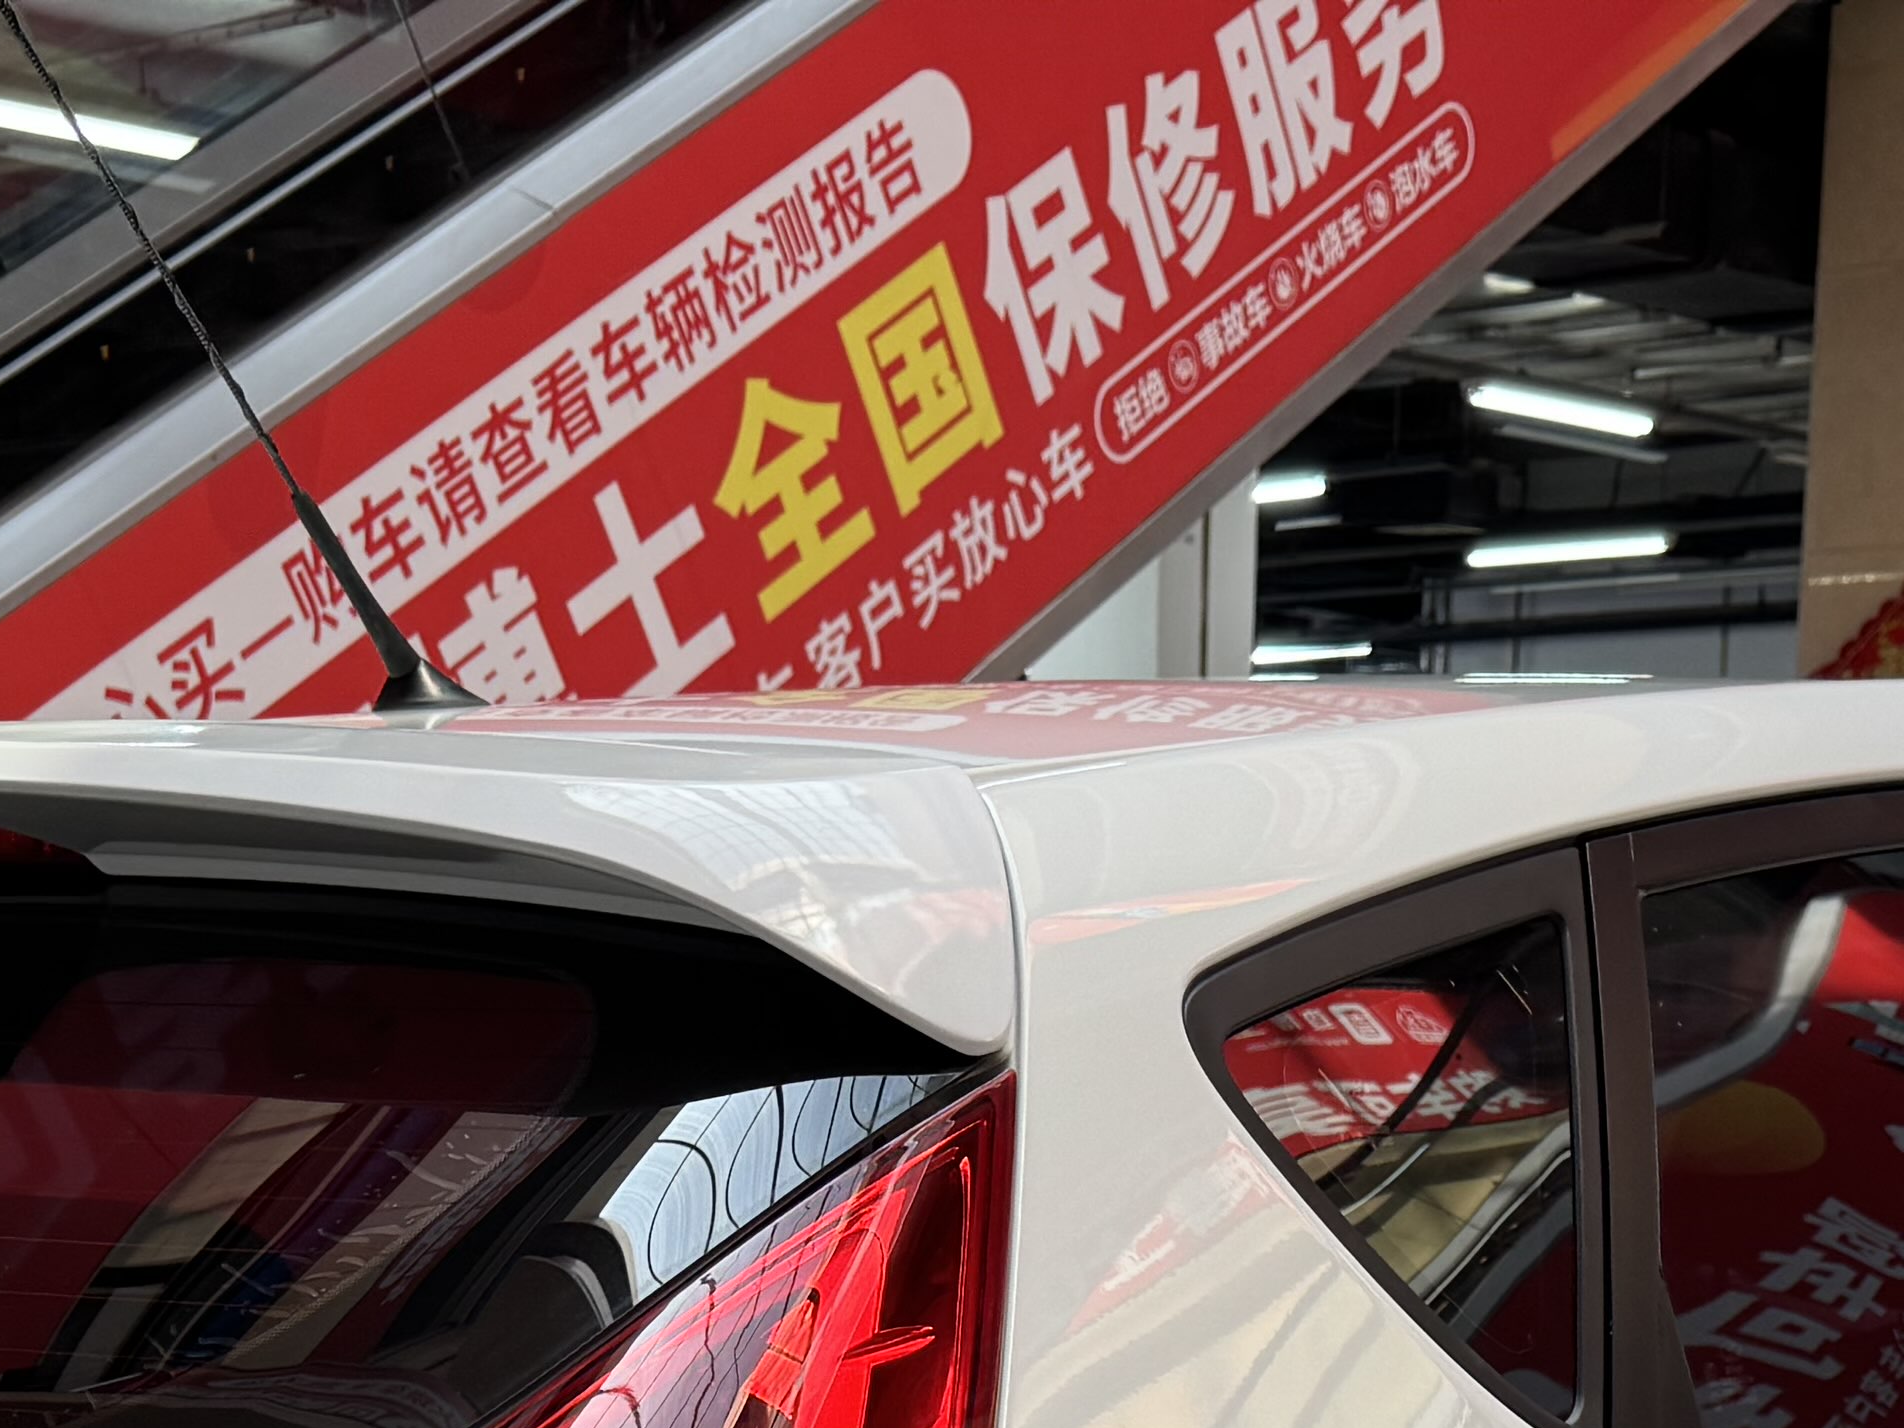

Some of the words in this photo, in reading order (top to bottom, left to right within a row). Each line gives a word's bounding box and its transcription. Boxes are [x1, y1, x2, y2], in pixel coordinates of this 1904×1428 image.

[1112, 367, 1171, 442] 拒绝
[1195, 281, 1273, 371] 事故车
[1297, 202, 1369, 291] 火烧车
[1389, 127, 1460, 215] 泡水车
